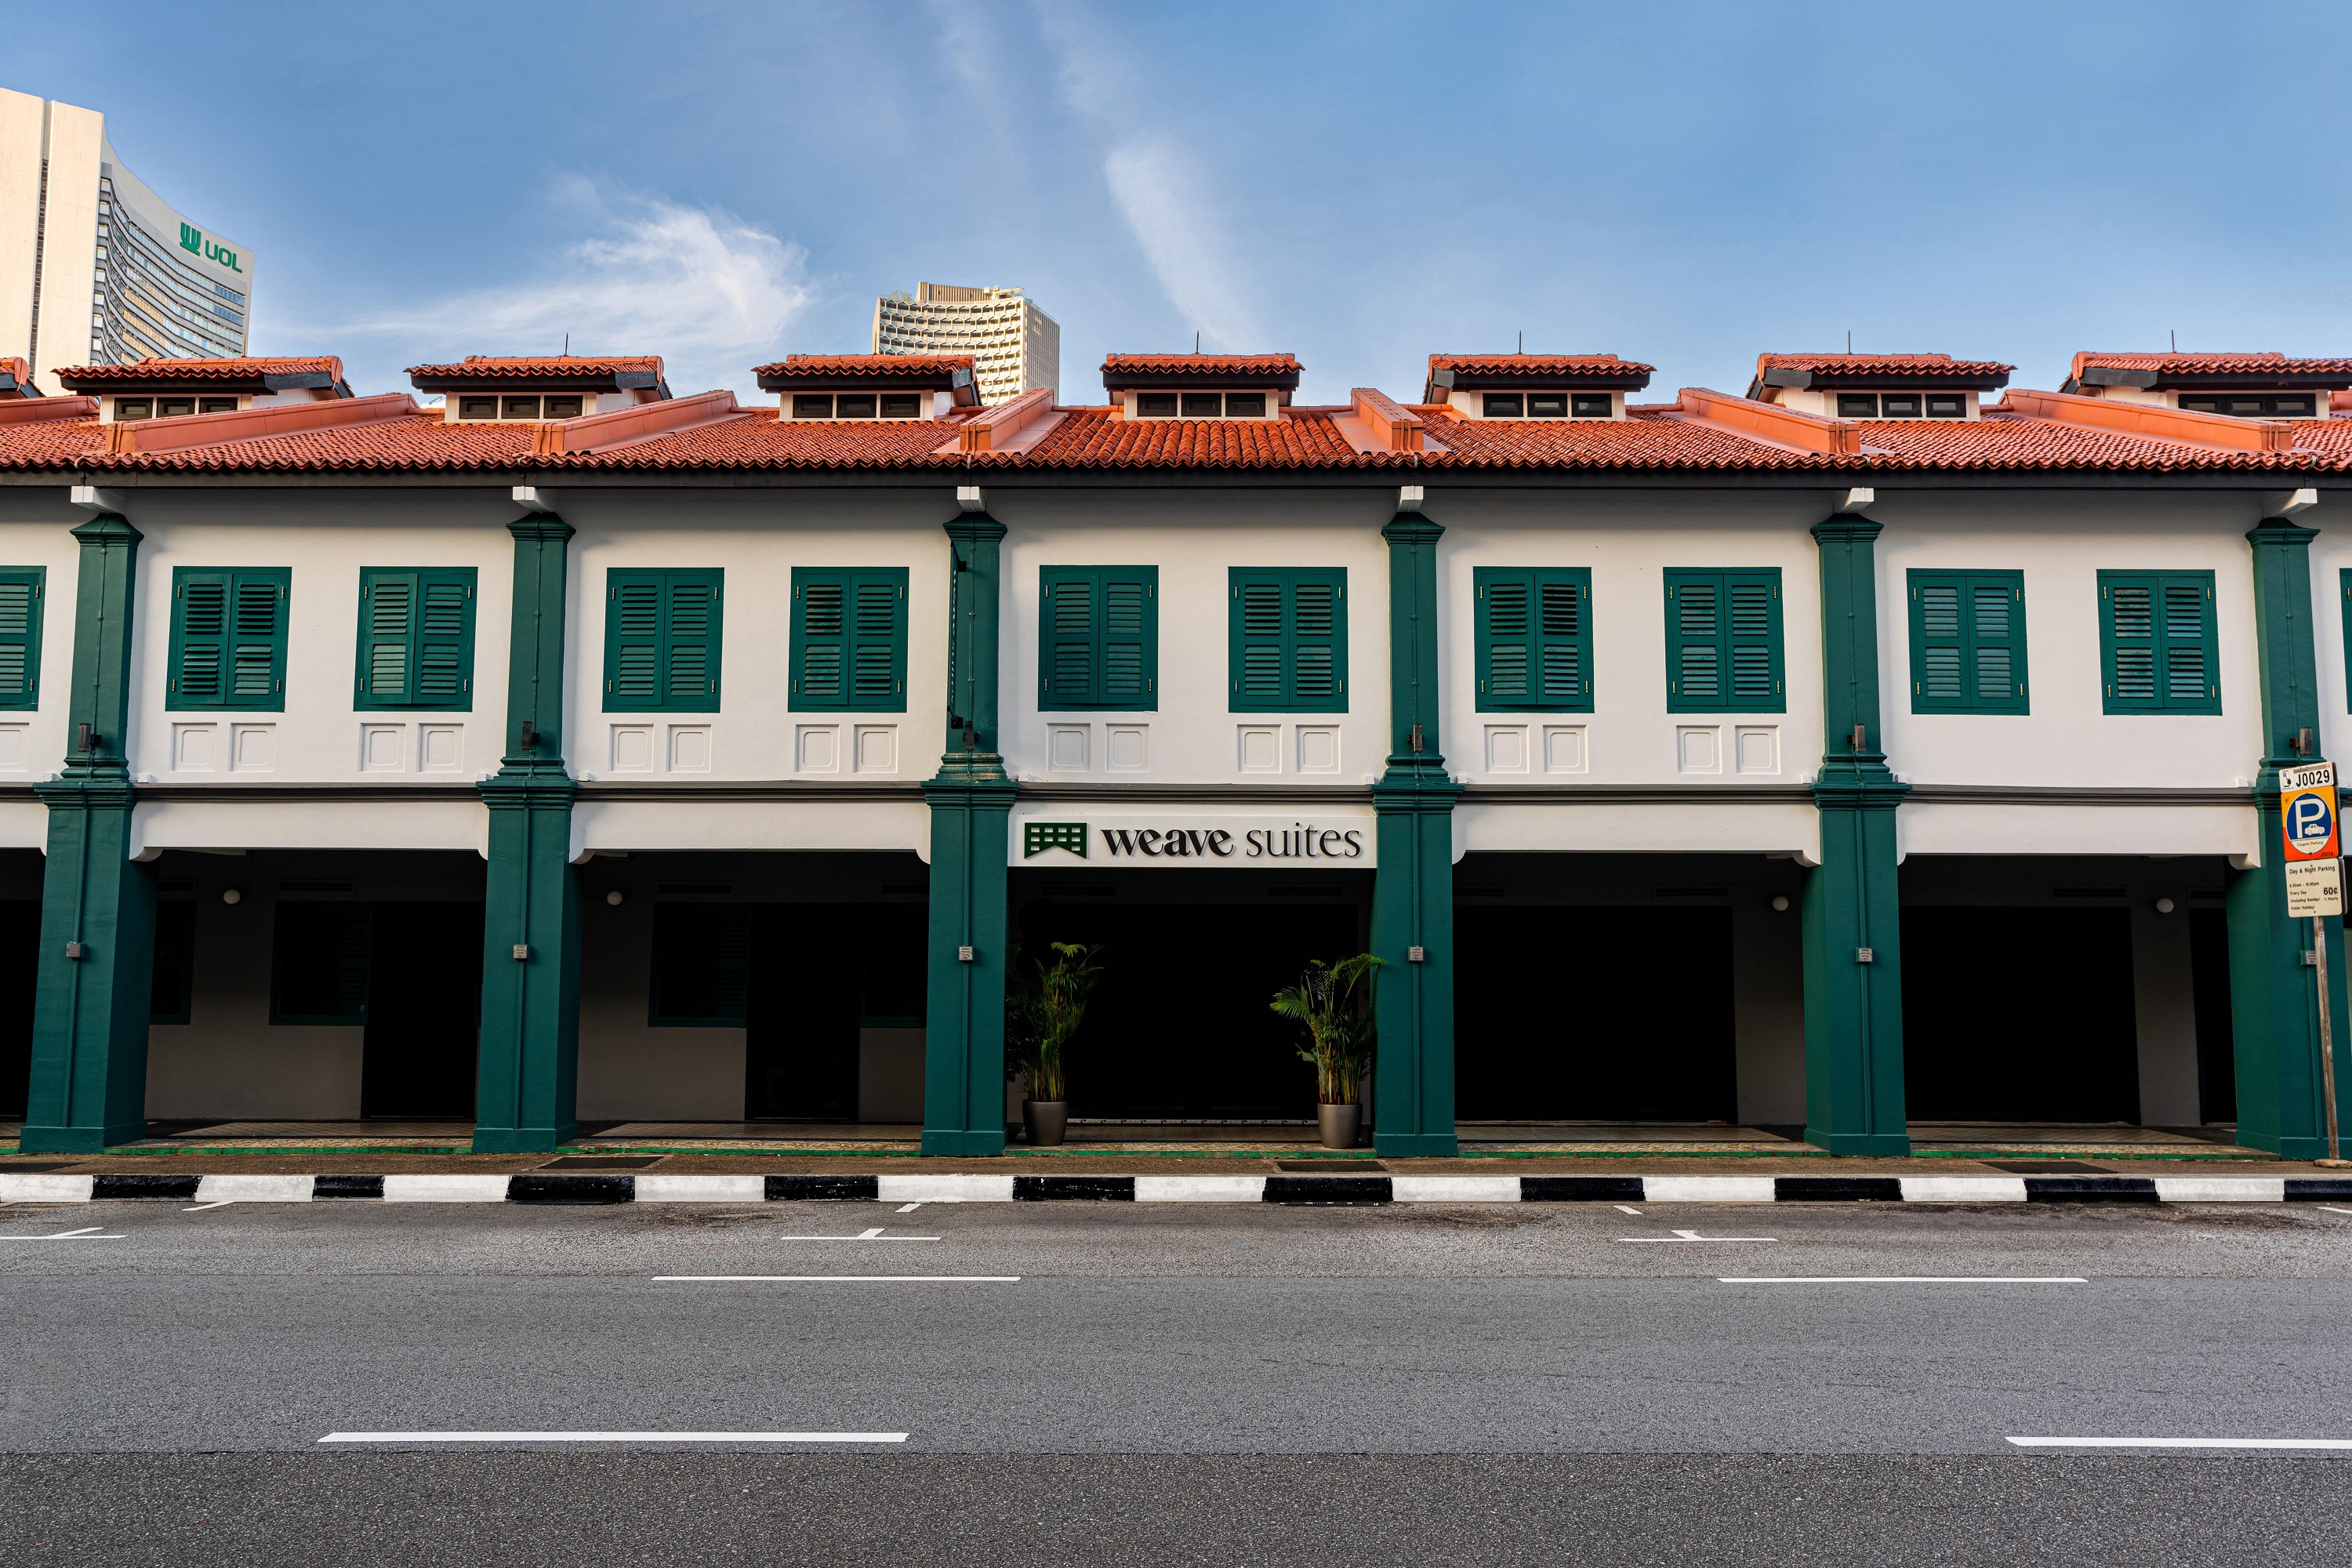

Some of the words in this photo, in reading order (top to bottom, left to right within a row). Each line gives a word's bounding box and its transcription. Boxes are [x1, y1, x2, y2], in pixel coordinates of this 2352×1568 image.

[205, 239, 243, 274] UOL
[2296, 769, 2330, 787] J0029
[2295, 798, 2326, 839] P
[1100, 828, 1234, 857] weave
[1246, 822, 1362, 858] suites
